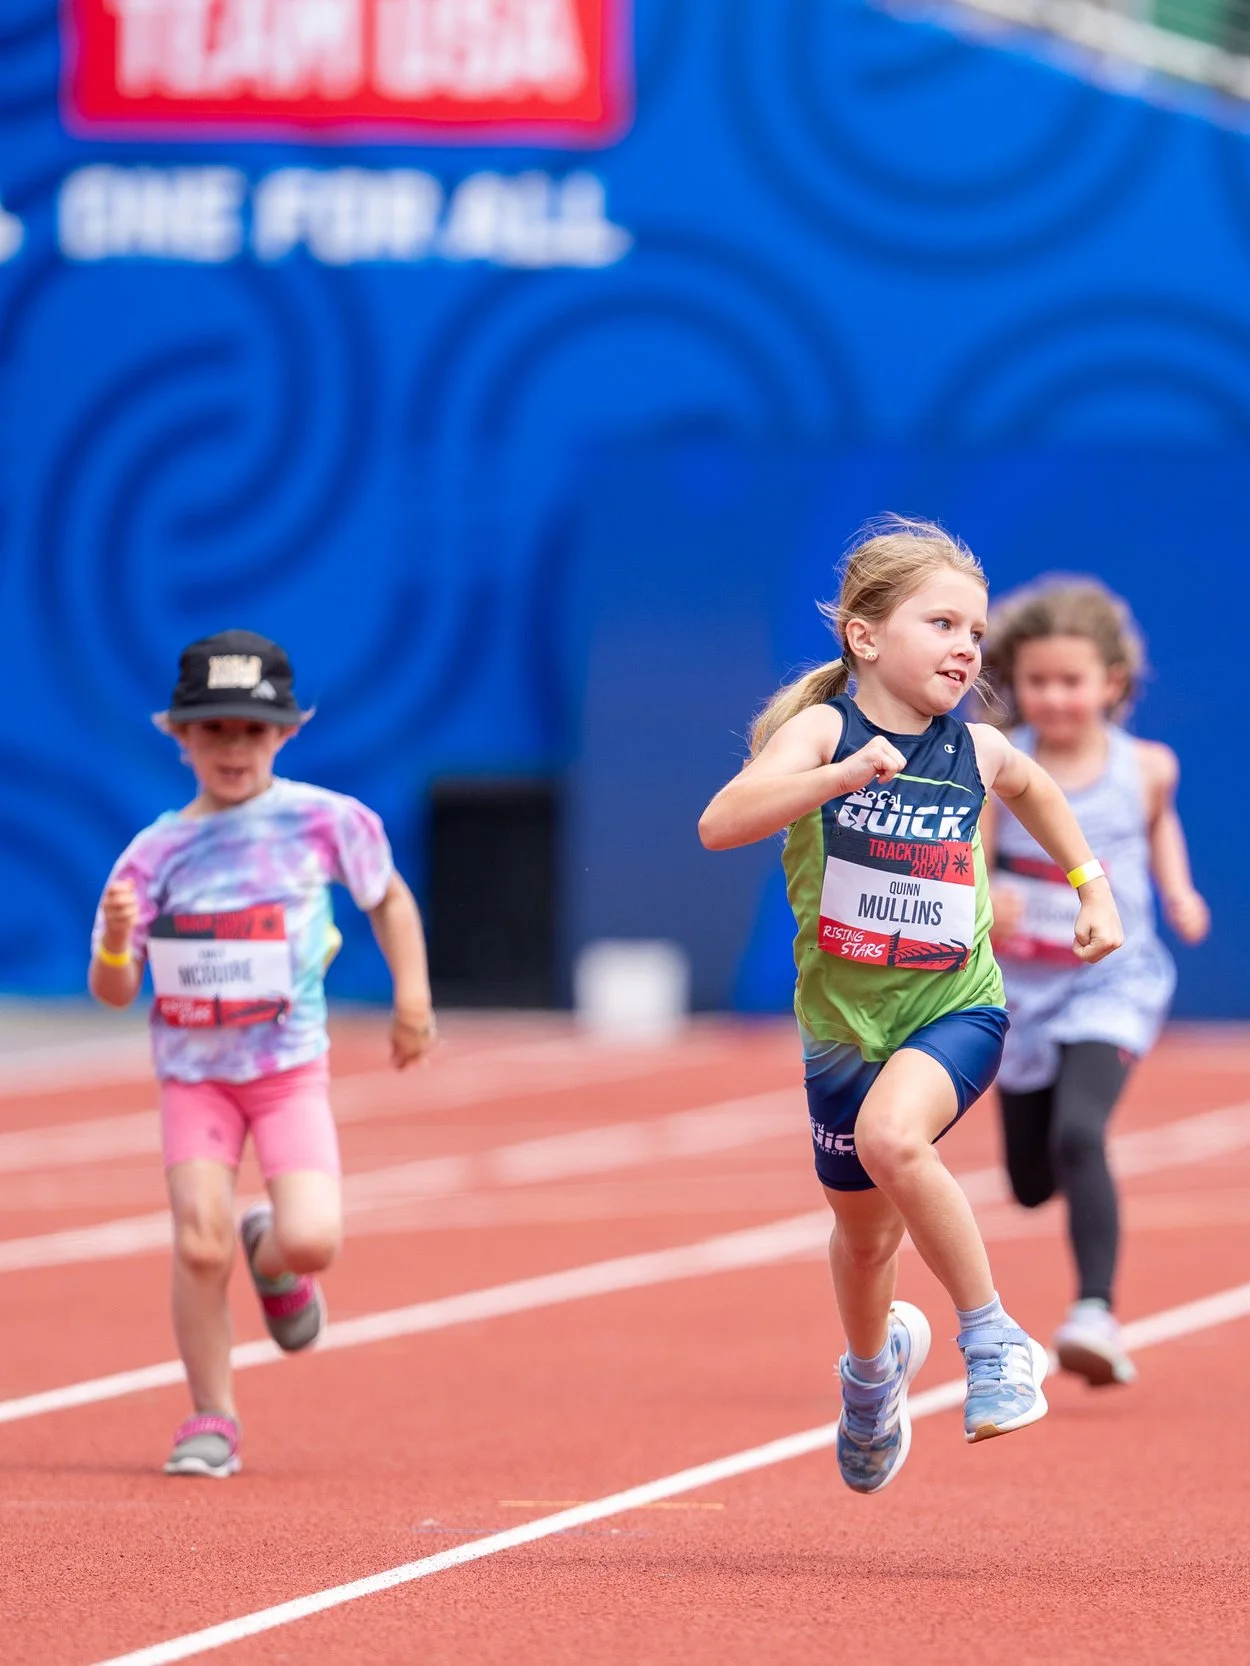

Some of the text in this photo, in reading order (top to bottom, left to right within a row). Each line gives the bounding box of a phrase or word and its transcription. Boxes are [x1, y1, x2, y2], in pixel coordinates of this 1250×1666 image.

[853, 787, 902, 806] SoCal
[837, 795, 971, 838] QUICK
[869, 838, 947, 865] TRACKTOWN
[911, 860, 944, 880] 2024
[889, 881, 921, 897] QUINN
[858, 893, 943, 926] MULLINS
[823, 925, 865, 943] RISING
[841, 942, 886, 958] STARS
